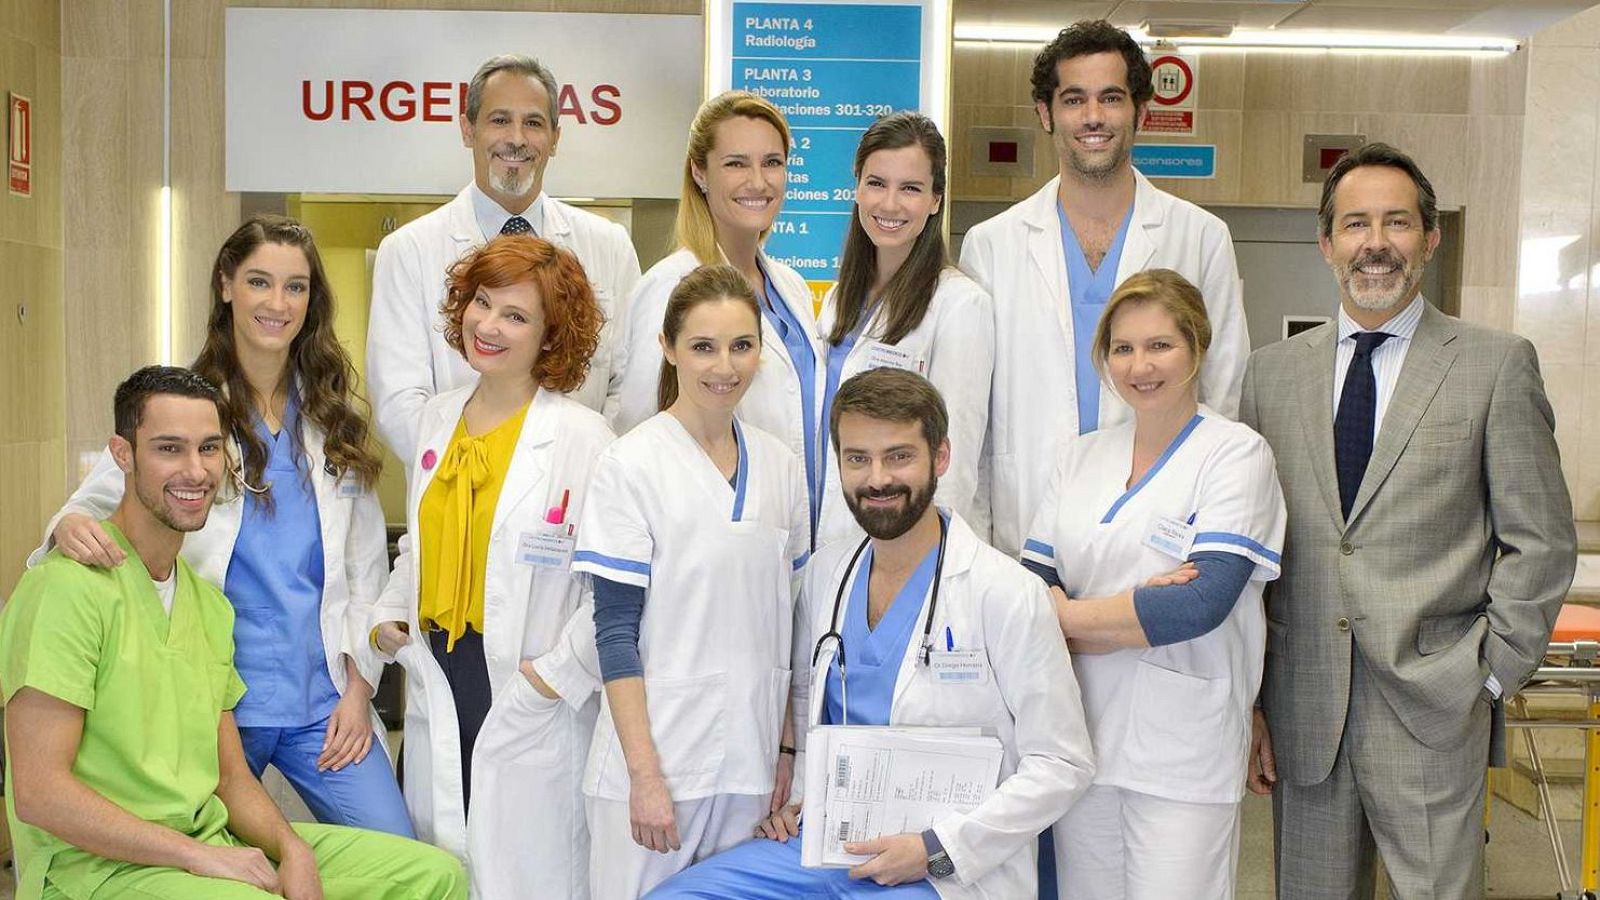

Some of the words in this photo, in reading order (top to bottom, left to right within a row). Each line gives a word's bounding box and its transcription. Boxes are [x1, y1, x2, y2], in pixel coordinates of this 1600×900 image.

[746, 18, 800, 30] PLANTA
[804, 19, 814, 30] 4
[745, 35, 816, 50] Radiología
[744, 68, 798, 81] PLANTA
[802, 69, 812, 81] 3
[302, 80, 622, 126] URGEAS
[835, 104, 893, 116] 301-320
[800, 137, 811, 149] 2
[833, 188, 857, 201] 201
[799, 222, 809, 234] 1
[832, 256, 841, 268] 1
